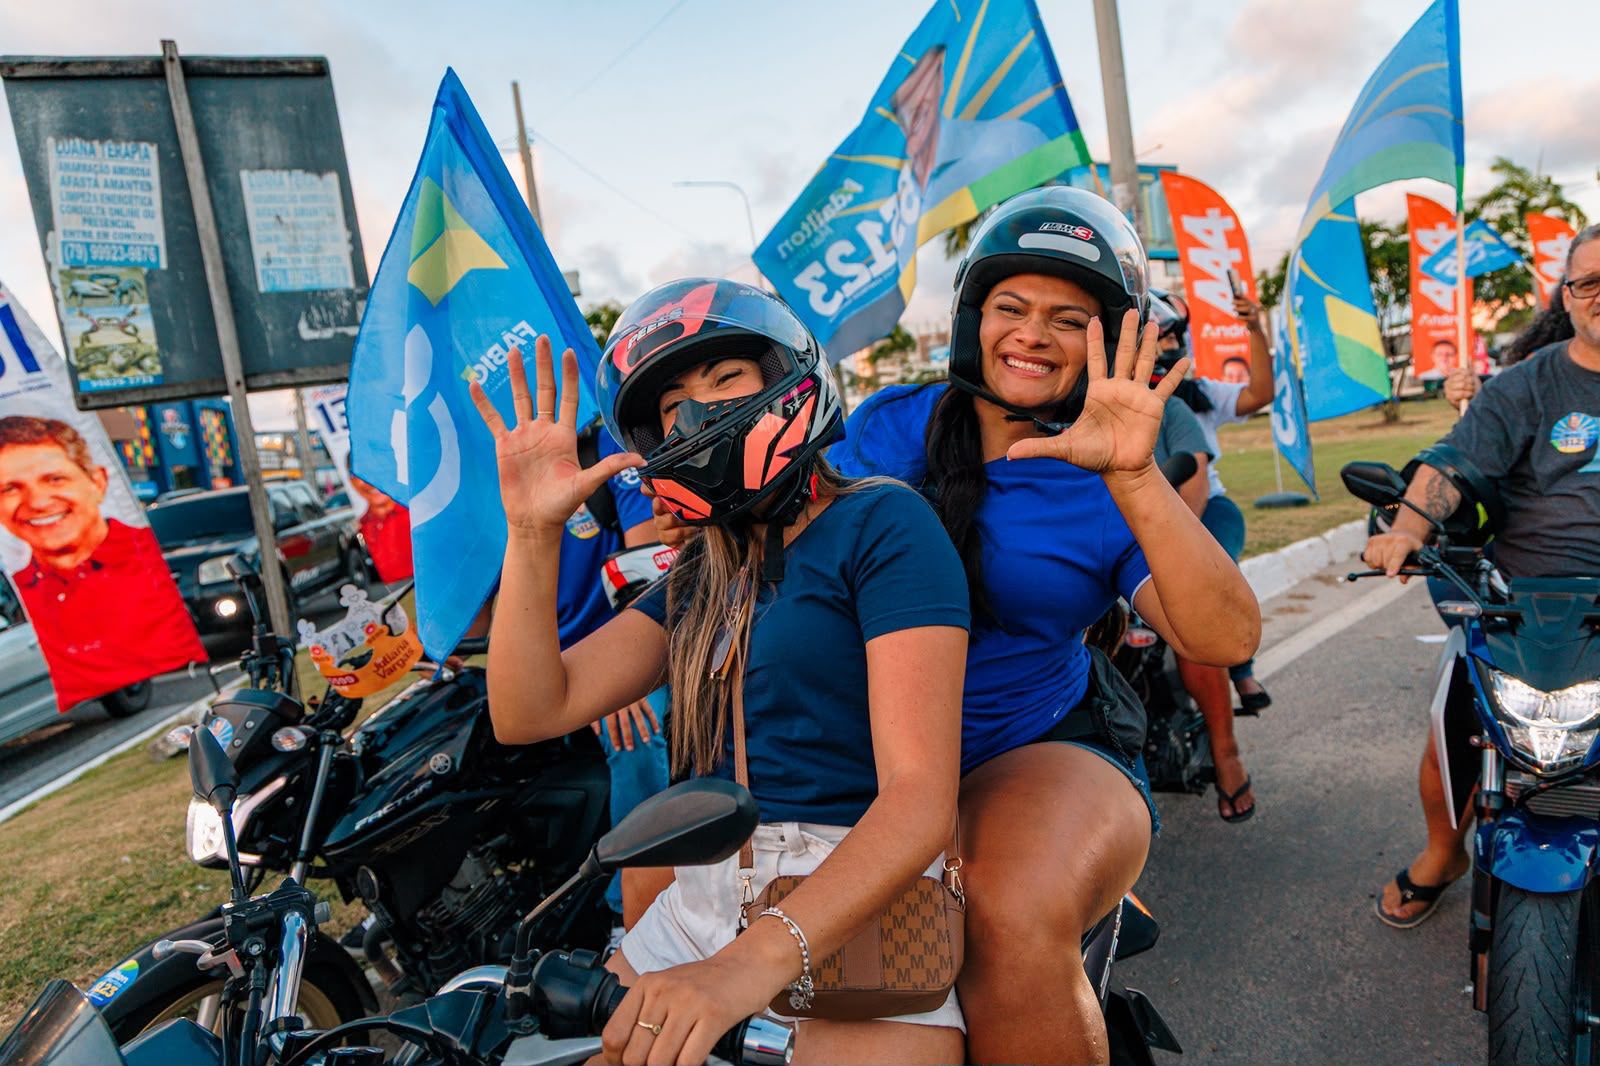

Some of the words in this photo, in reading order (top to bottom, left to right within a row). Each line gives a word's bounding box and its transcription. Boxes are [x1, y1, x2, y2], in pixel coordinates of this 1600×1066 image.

[1201, 322, 1250, 339] Andr
[919, 891, 932, 903] M
[906, 904, 919, 916] M
[893, 916, 906, 928] M
[922, 916, 935, 928] M
[881, 929, 893, 942] M
[908, 929, 921, 942] M
[938, 929, 950, 942] M
[895, 942, 908, 955] M
[924, 942, 938, 955] M
[824, 955, 836, 968] M
[882, 955, 895, 968] M
[911, 955, 924, 968] M
[940, 955, 952, 968] M
[897, 968, 910, 982] M
[926, 968, 940, 982] M
